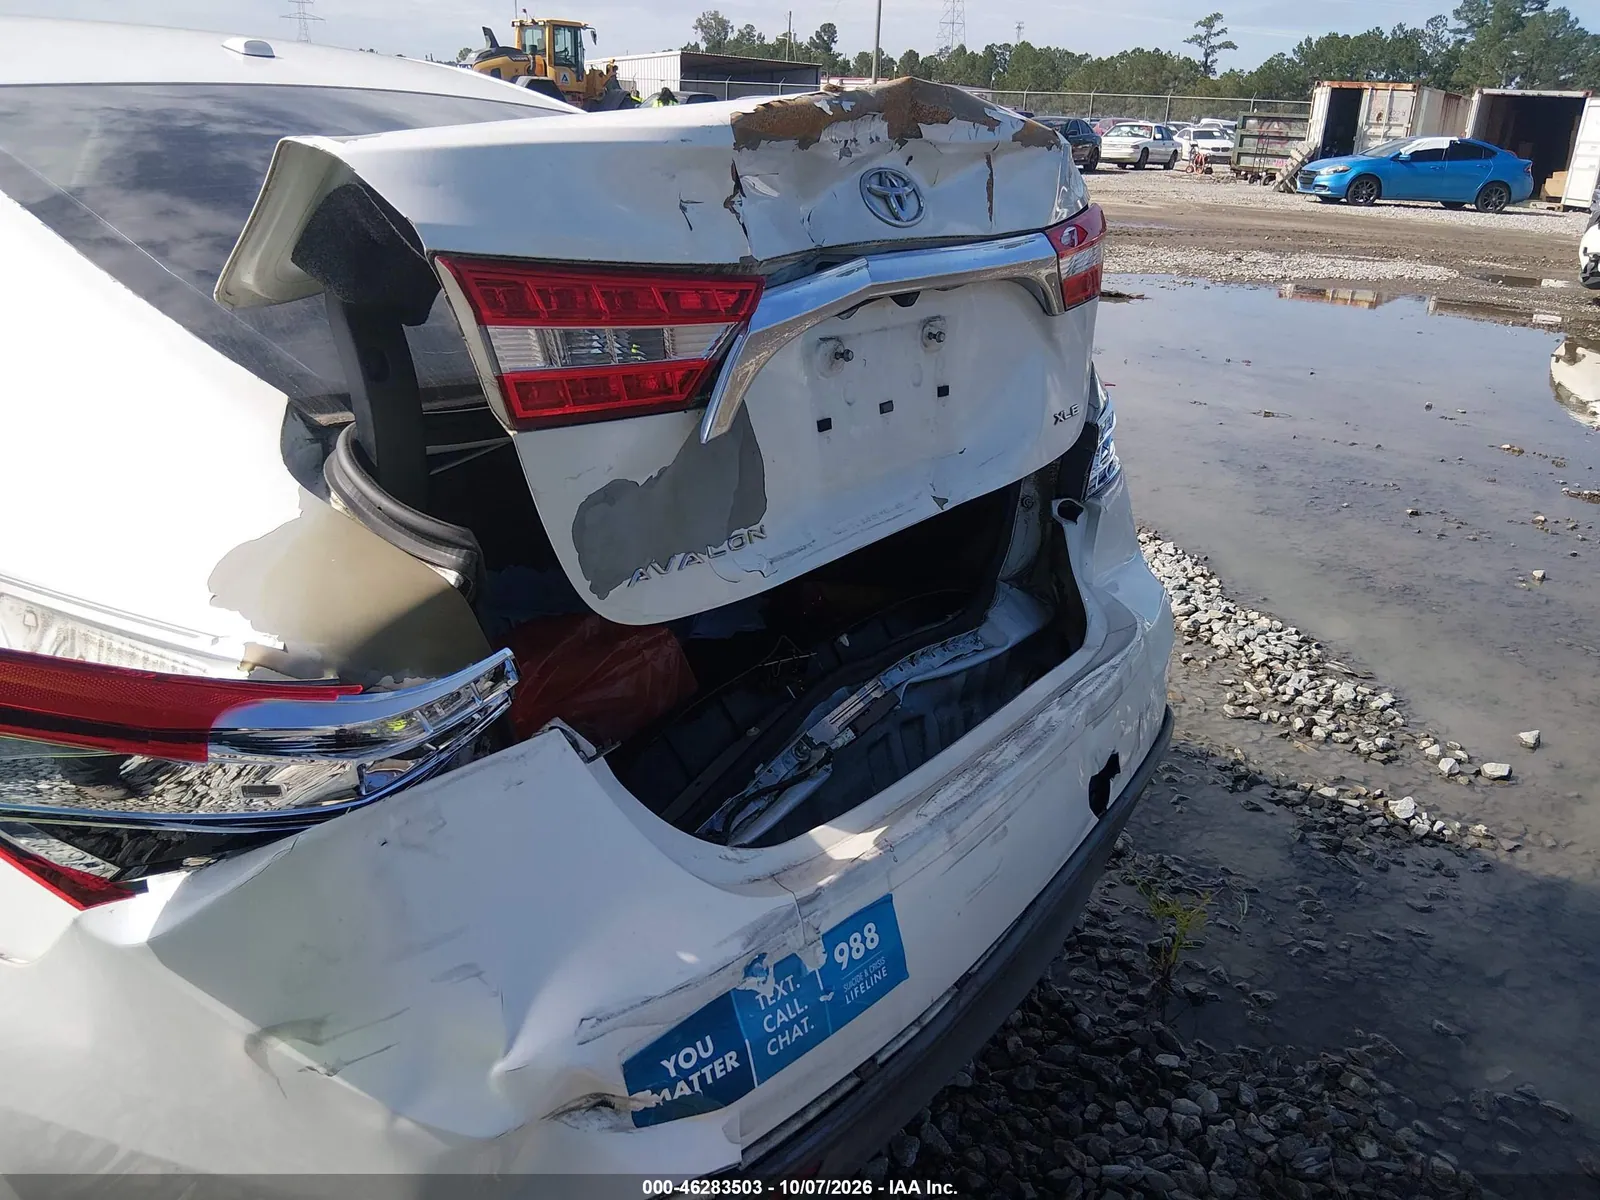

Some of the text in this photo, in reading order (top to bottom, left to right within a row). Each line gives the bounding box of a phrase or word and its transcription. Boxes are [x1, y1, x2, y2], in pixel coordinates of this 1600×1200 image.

[1053, 404, 1080, 426] XLE
[627, 524, 767, 588] AVALON
[834, 922, 880, 971] 988
[845, 965, 888, 1005] LIFELINE
[763, 998, 809, 1033] CALL.
[767, 1016, 815, 1056] CHAT.
[660, 1035, 714, 1078] YOU
